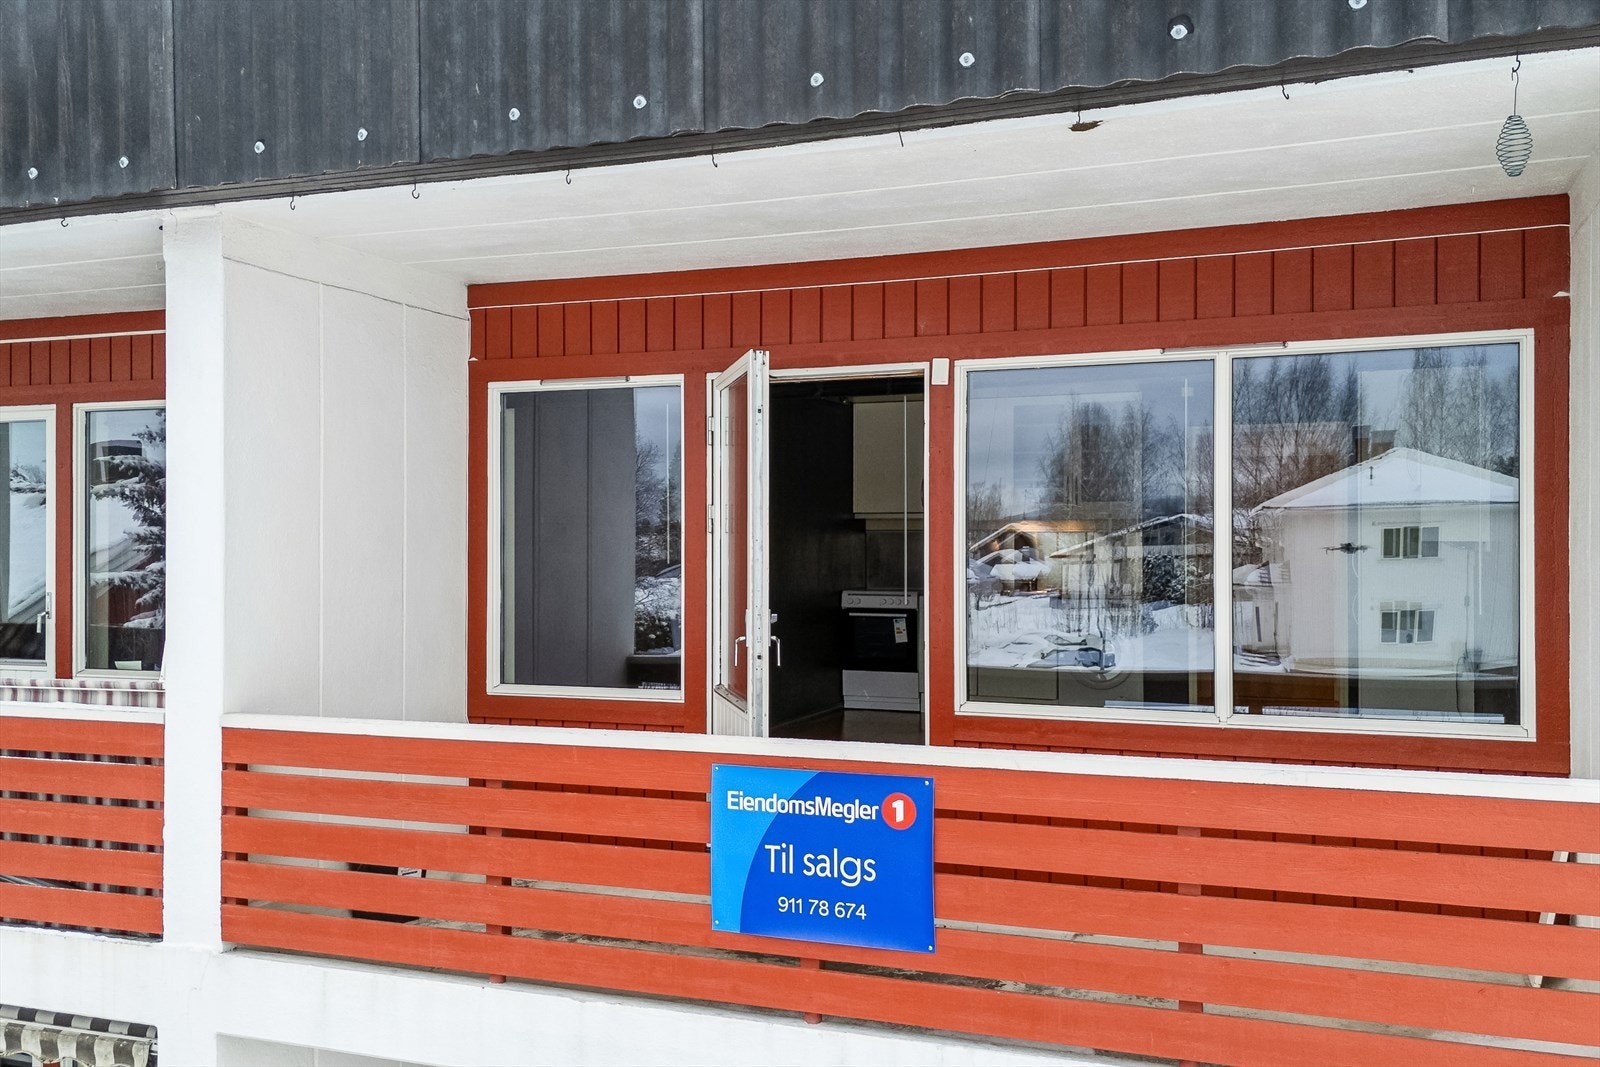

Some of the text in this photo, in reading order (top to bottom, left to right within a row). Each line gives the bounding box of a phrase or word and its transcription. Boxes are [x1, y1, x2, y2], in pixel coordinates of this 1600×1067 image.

[727, 790, 905, 824] EiendomsMegler 1
[764, 843, 876, 887] Til salgs
[777, 897, 867, 920] 911 78 674
